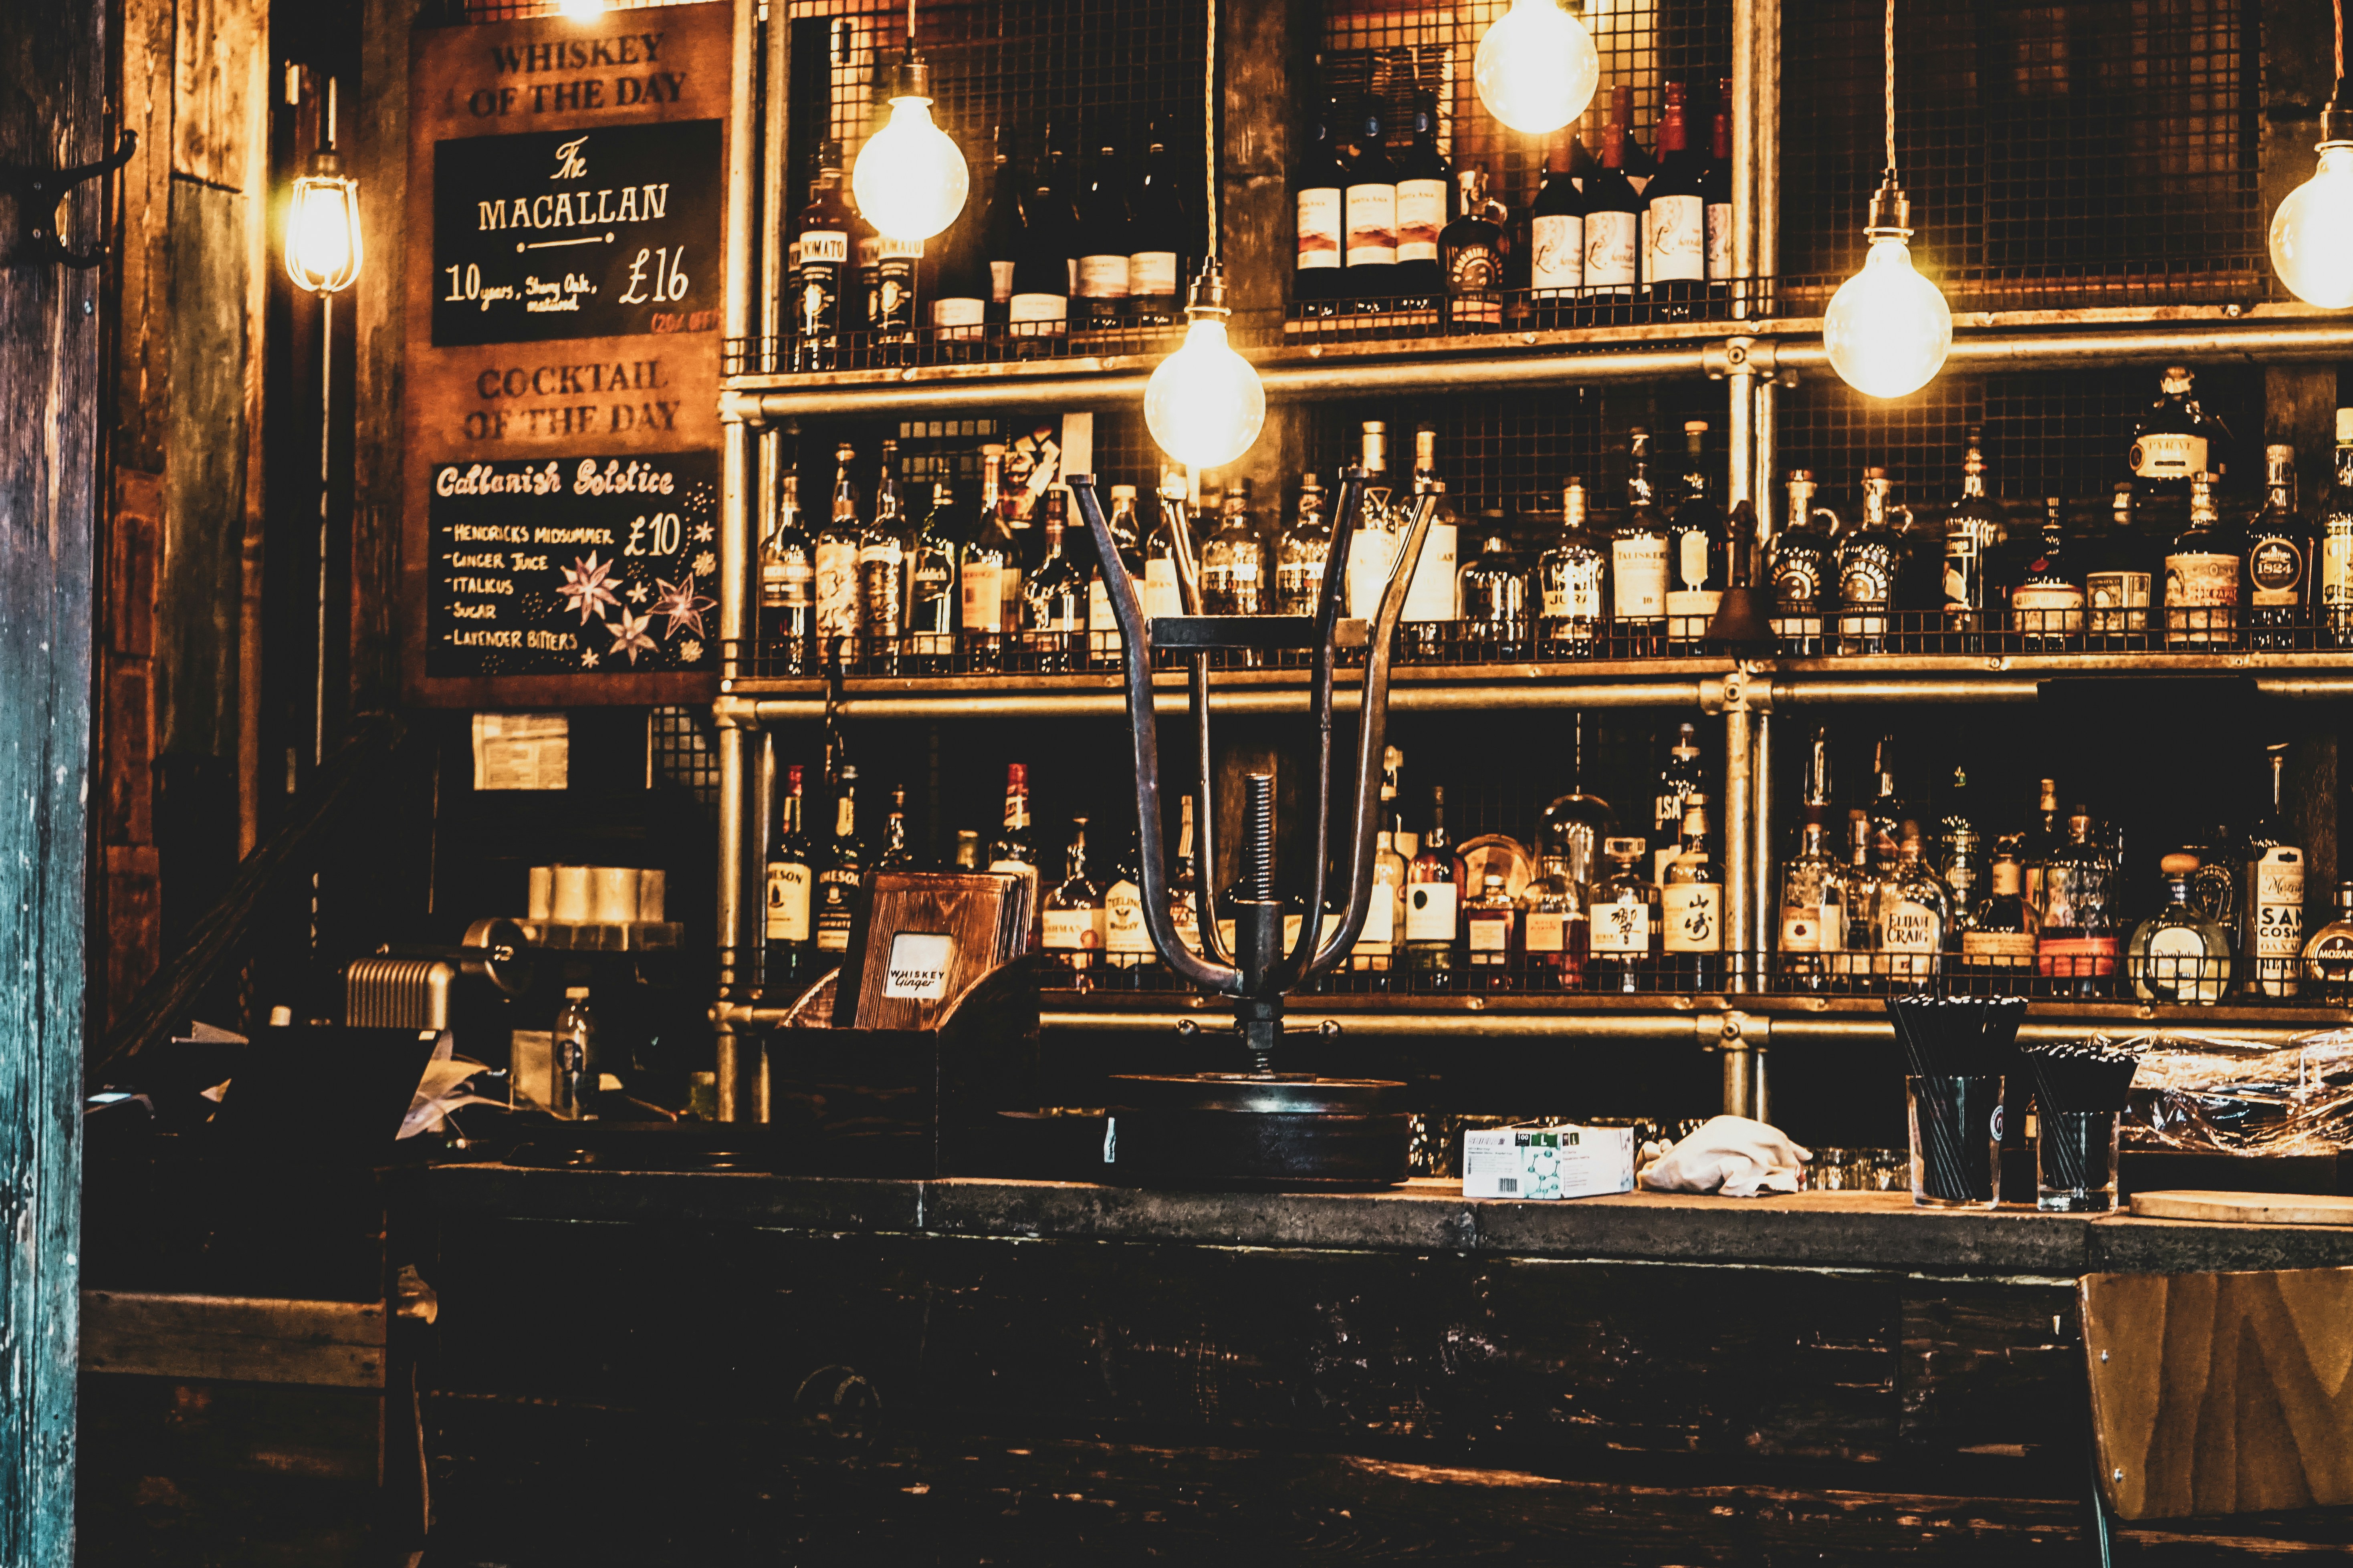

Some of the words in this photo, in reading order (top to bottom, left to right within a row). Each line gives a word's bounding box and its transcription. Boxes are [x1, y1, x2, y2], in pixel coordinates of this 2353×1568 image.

[491, 33, 664, 75] WHISKEY
[469, 87, 517, 118] OF
[532, 80, 603, 114] THE
[617, 73, 686, 107] DAY
[550, 135, 589, 179] The
[478, 183, 669, 231] MACALLAN
[619, 245, 689, 304] £16
[477, 360, 668, 400] COCKTAIL
[463, 409, 512, 441] OF
[521, 405, 597, 436] THE
[610, 399, 680, 433] DAY
[436, 462, 561, 497] Callanish
[573, 459, 675, 496] Solstice
[624, 512, 680, 556] £10
[2258, 562, 2293, 574] 1824
[1887, 928, 1928, 945] CRAIG
[1889, 913, 1928, 928] ELIJAH
[891, 970, 944, 979] WHISKEY
[896, 974, 934, 991] Ginger
